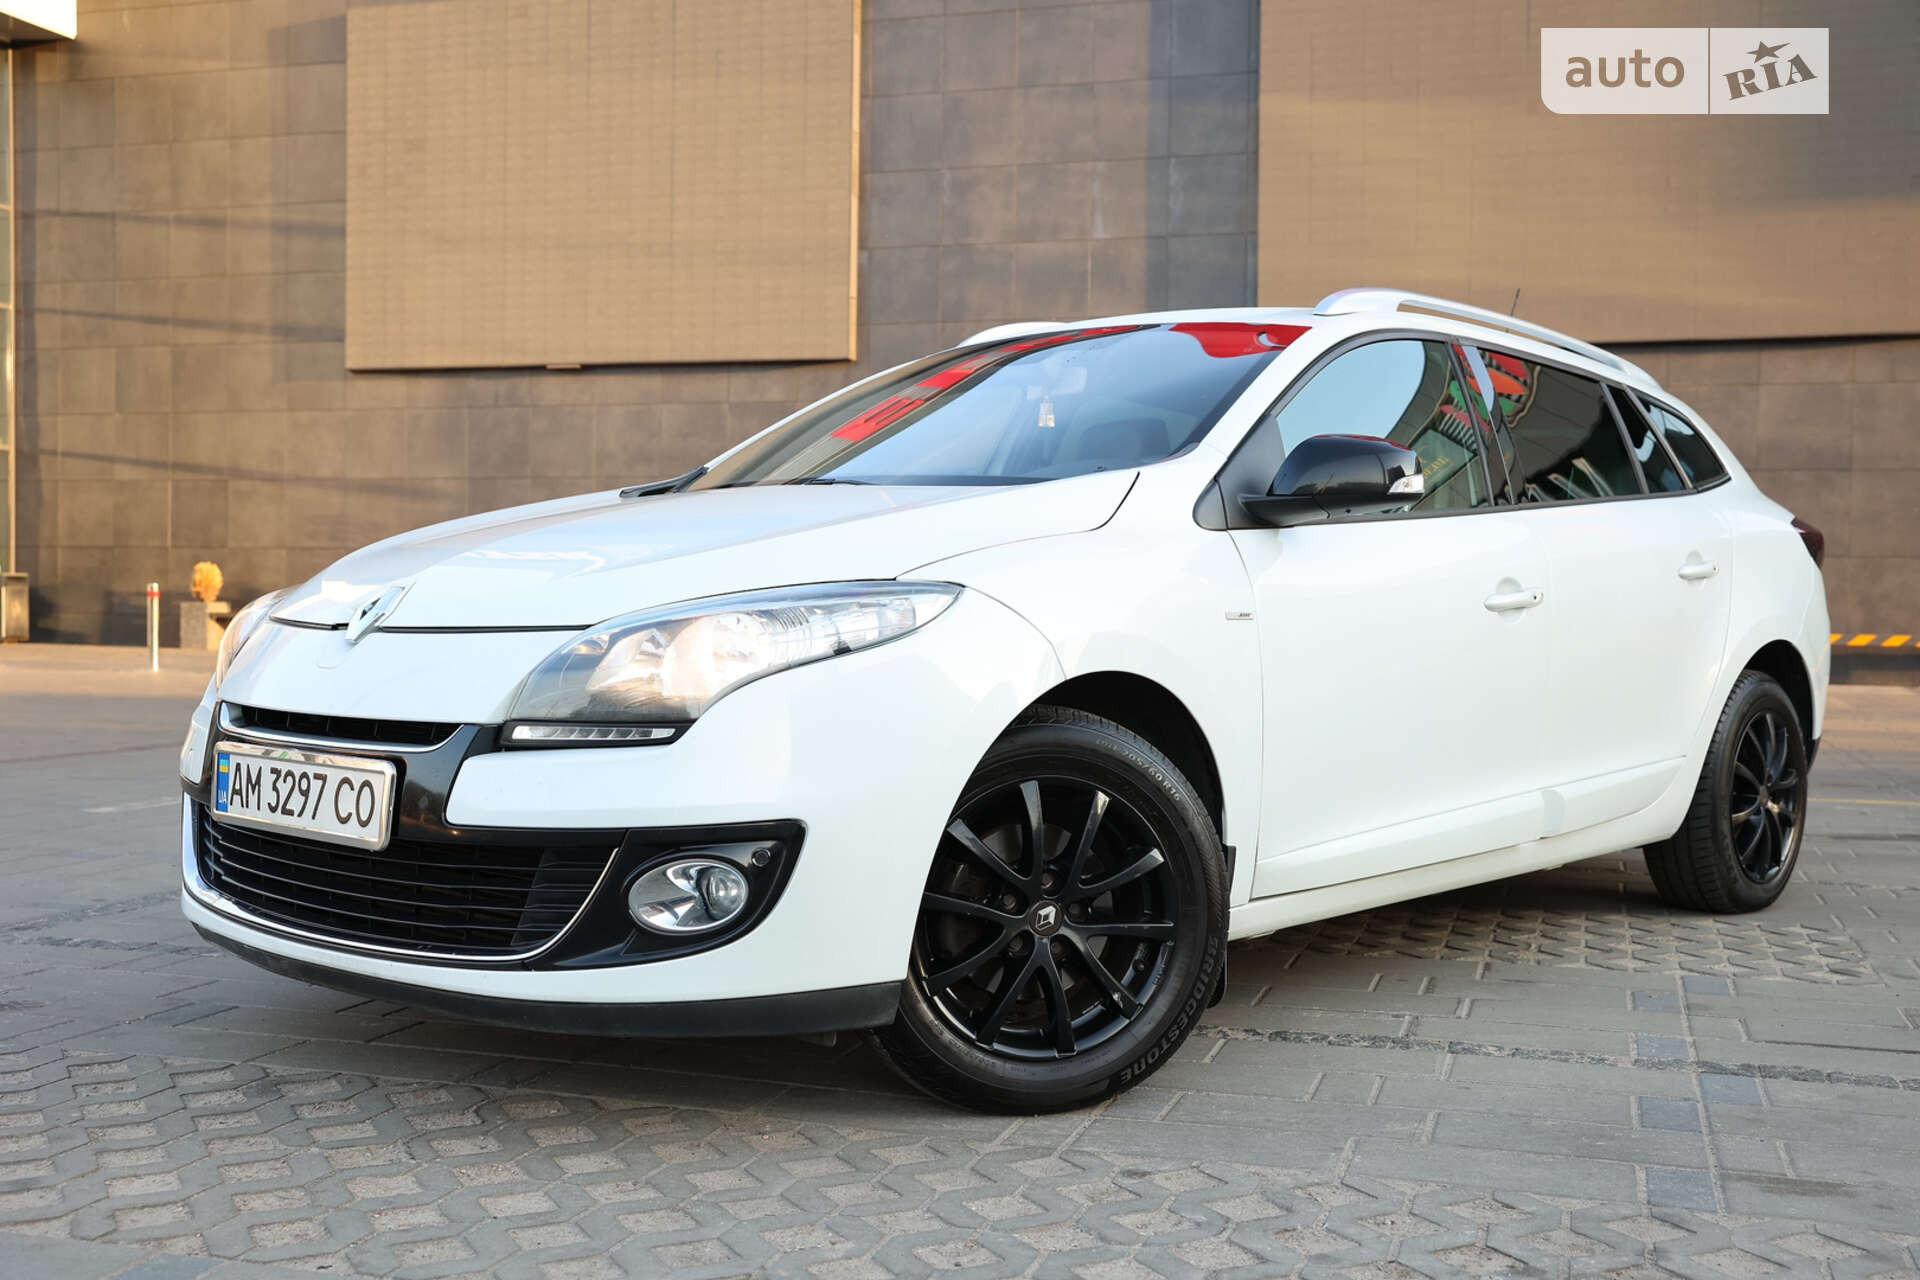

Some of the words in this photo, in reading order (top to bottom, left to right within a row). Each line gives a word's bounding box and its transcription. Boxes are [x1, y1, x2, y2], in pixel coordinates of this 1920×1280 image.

[230, 762, 263, 811] AM
[267, 767, 328, 820] 3297
[334, 776, 375, 828] CO
